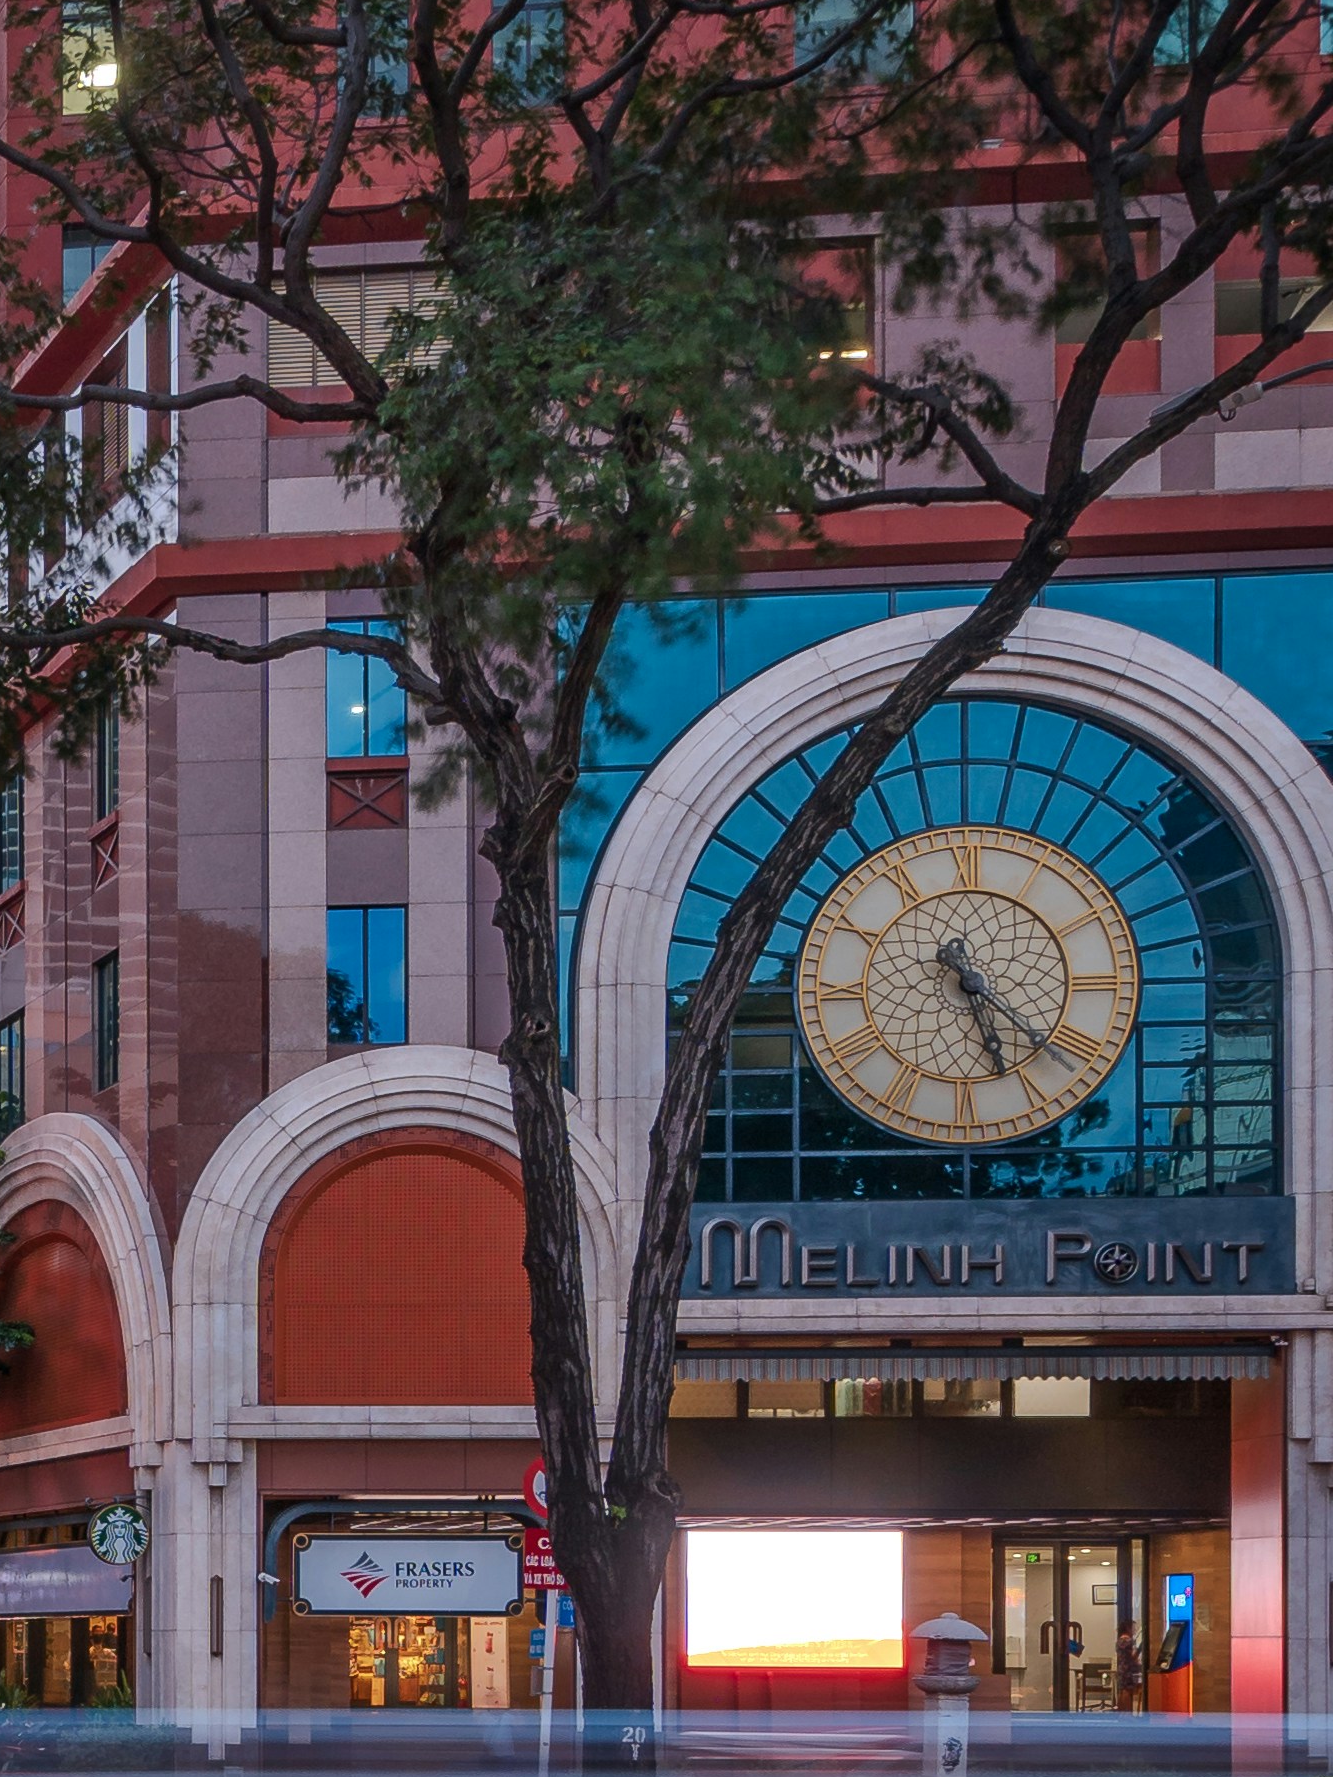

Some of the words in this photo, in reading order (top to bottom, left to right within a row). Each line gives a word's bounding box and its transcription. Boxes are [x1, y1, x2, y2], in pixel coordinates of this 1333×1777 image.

[701, 1217, 1004, 1287] MELINH
[538, 1537, 552, 1549] C
[395, 1561, 475, 1576] FRASERS
[395, 1579, 453, 1588] PROPERTY
[622, 1726, 646, 1743] 20
